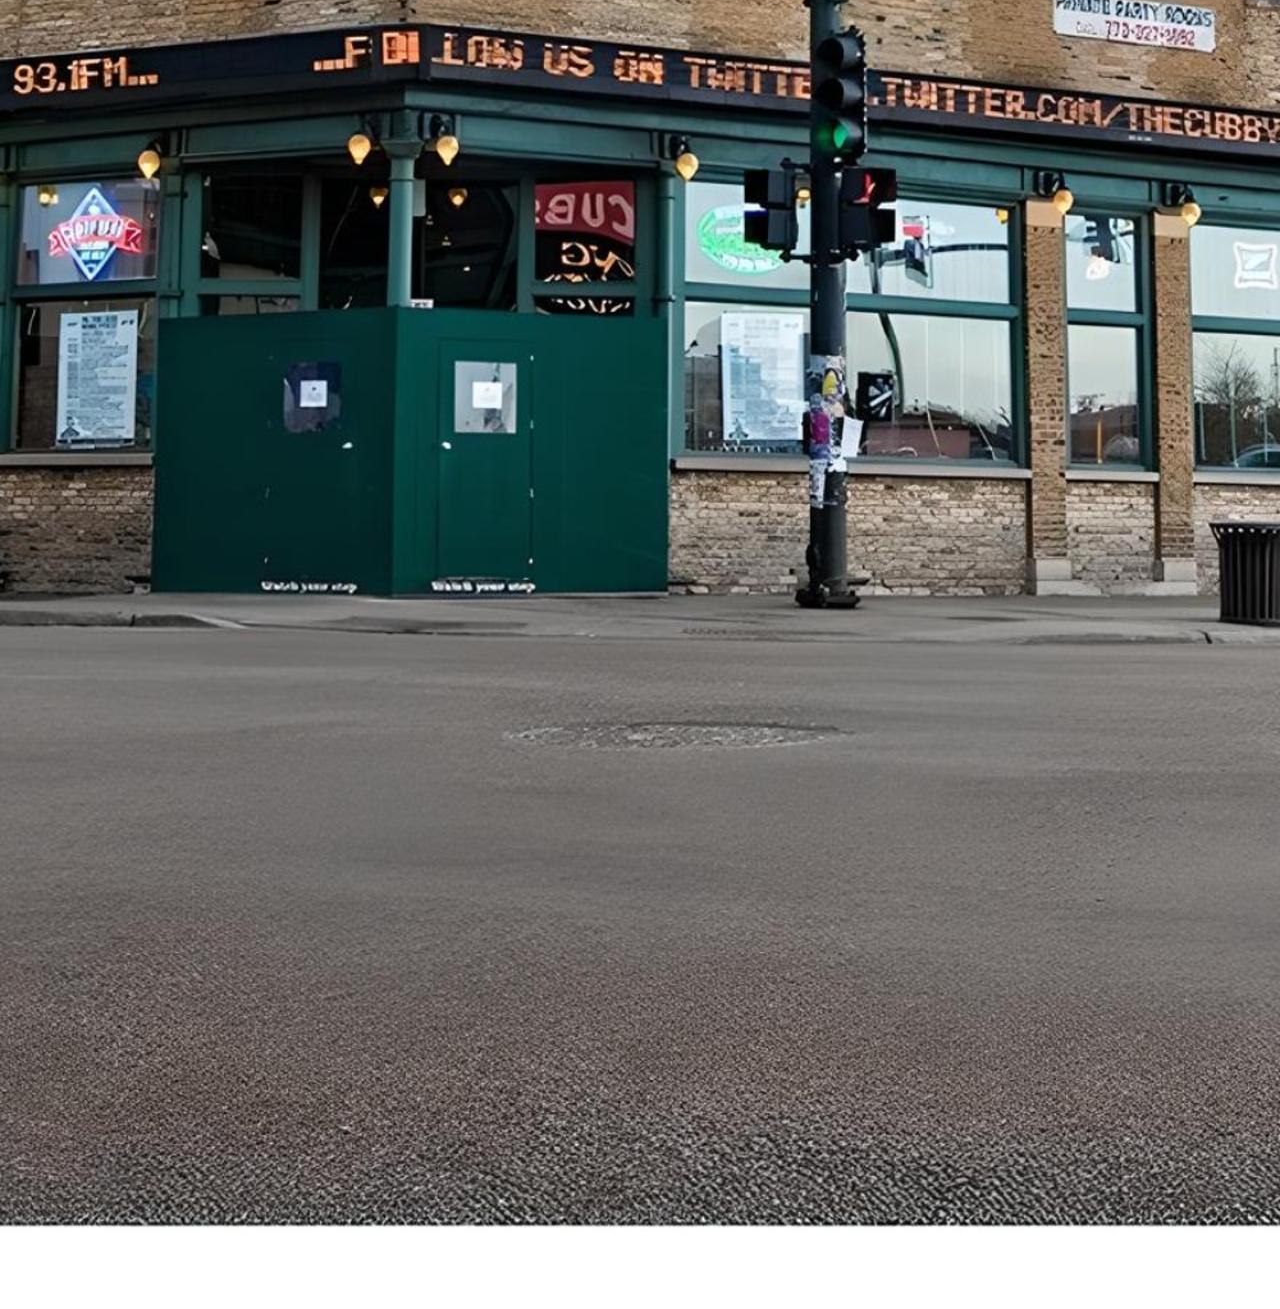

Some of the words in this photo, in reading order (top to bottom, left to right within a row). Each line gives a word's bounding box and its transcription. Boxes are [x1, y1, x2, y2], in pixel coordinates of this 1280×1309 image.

[1115, 0, 1162, 21] PARTY
[544, 44, 595, 79] US
[613, 50, 664, 86] ON
